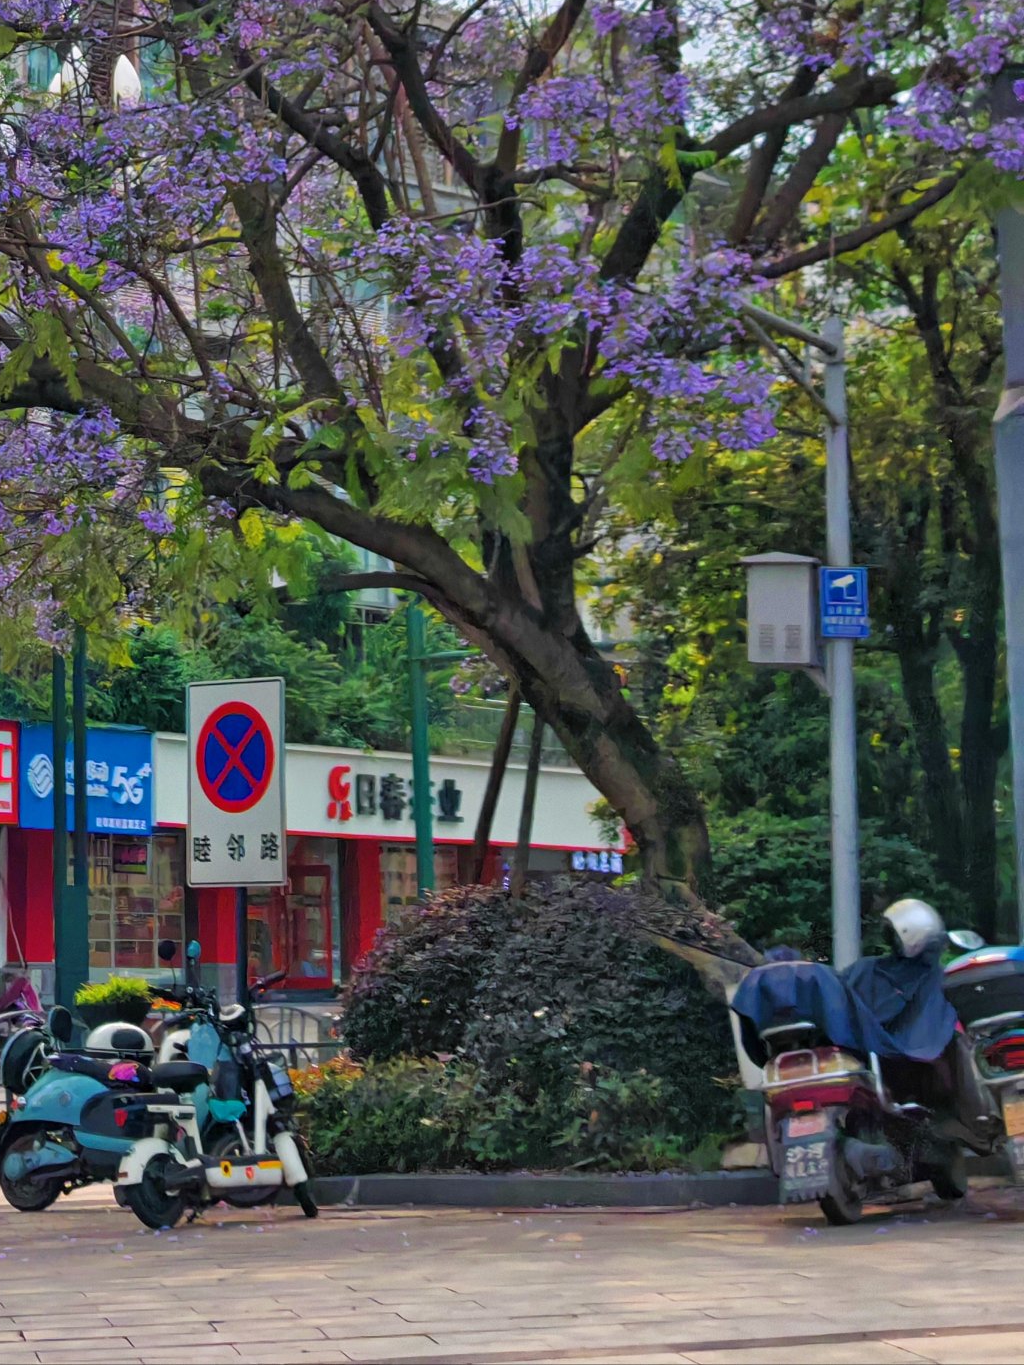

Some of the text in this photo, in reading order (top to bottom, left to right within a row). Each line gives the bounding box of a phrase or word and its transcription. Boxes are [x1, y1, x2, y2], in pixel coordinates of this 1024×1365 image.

[356, 772, 464, 823] 日春业
[193, 832, 279, 862] 睦邻路
